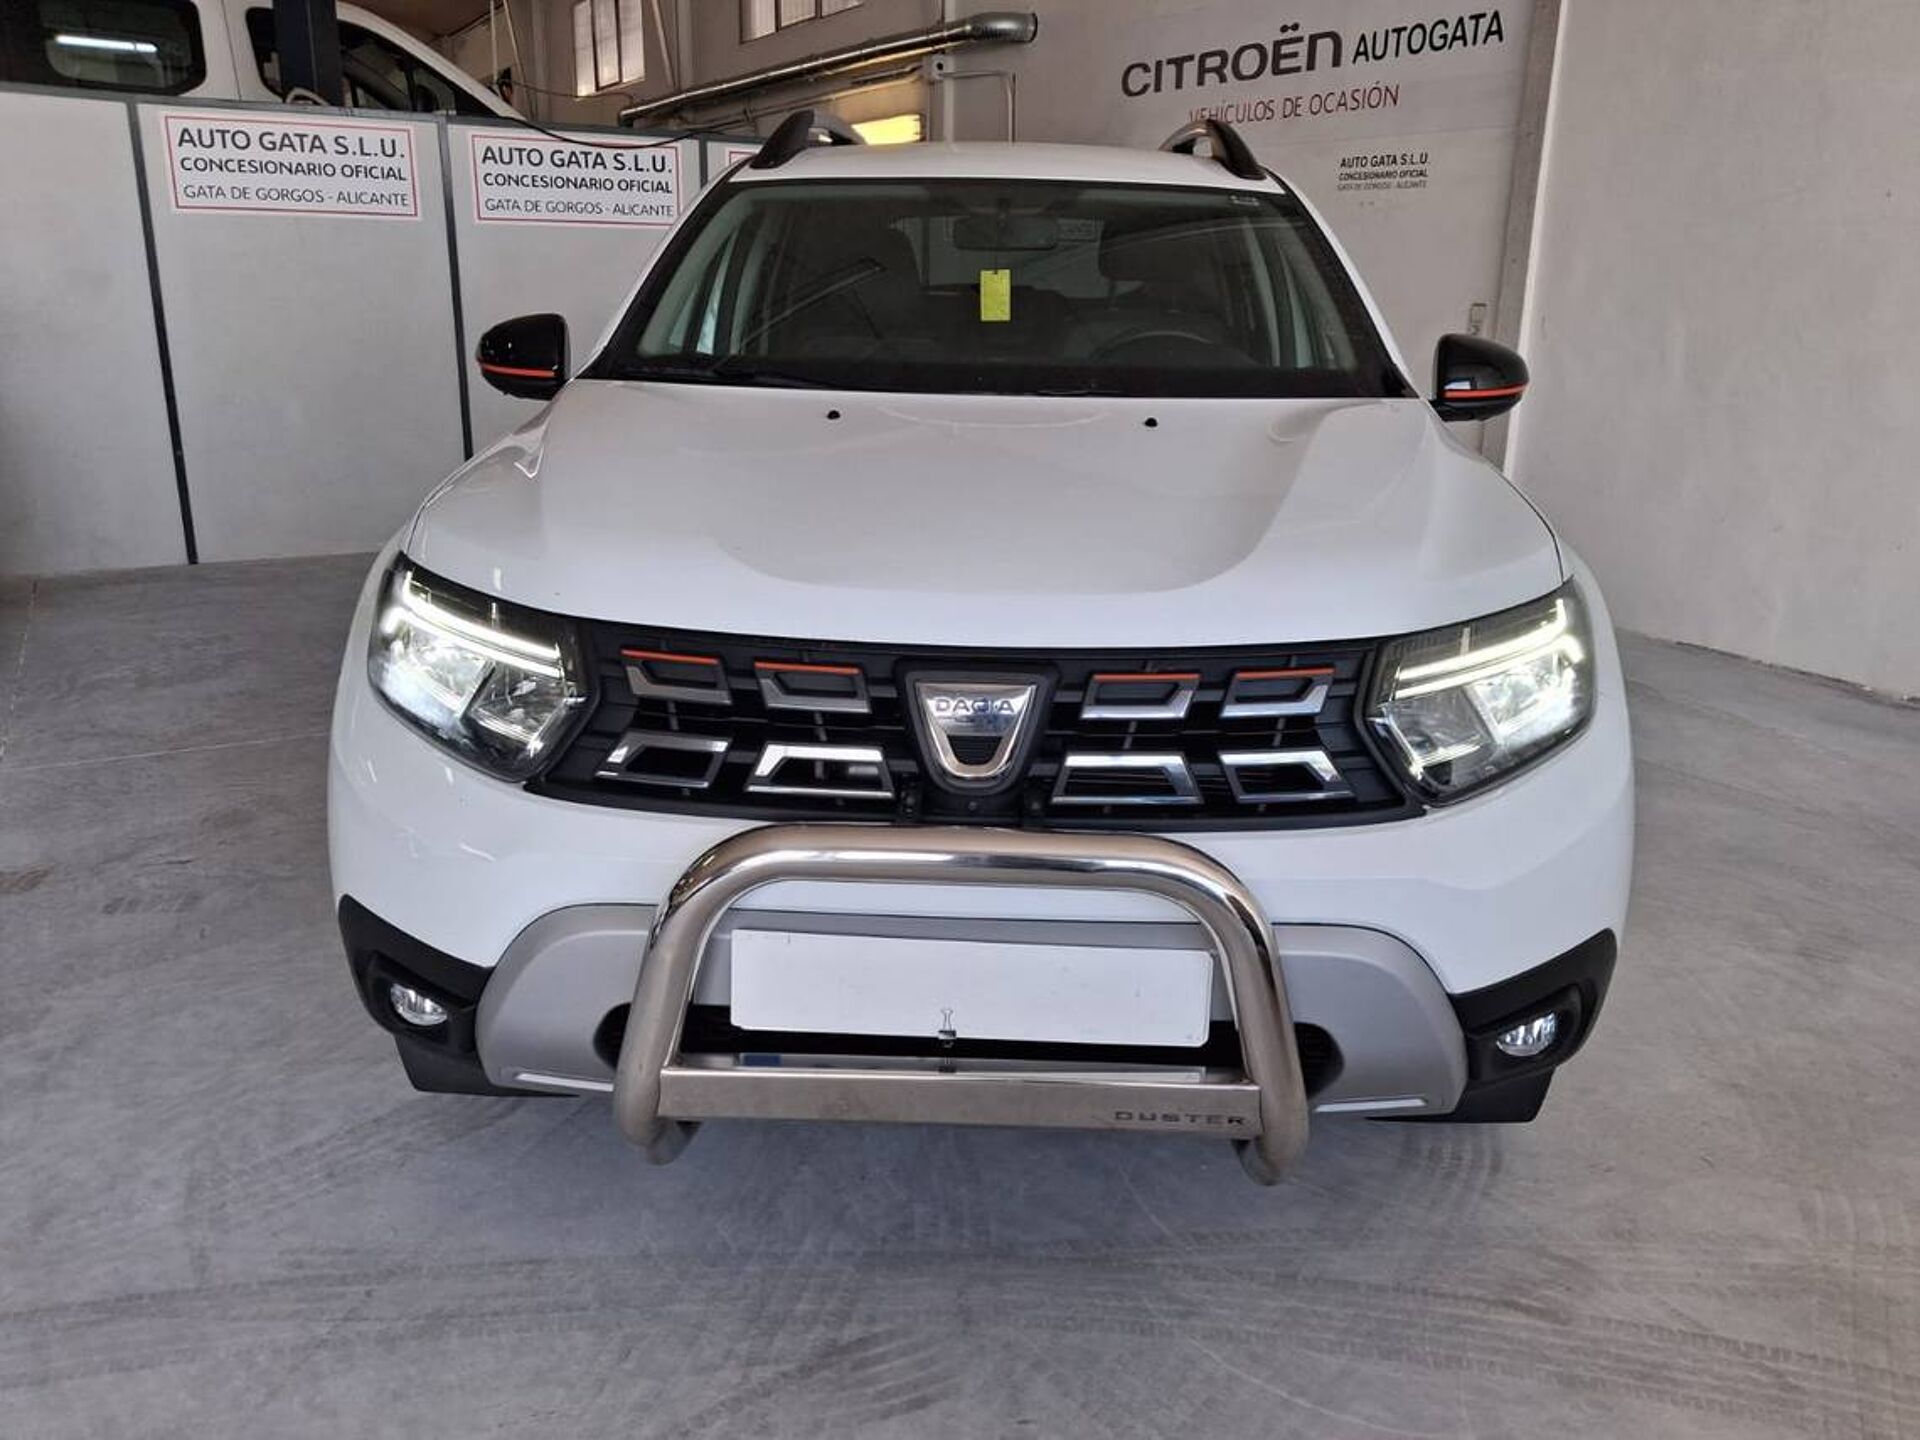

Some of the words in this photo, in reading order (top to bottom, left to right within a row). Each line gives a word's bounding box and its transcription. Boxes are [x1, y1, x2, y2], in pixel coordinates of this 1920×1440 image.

[1352, 9, 1504, 65] AUTOGATA
[1282, 96, 1303, 119] DE
[1309, 81, 1400, 115] OCASIÓN
[178, 127, 251, 150] AUTO
[258, 131, 328, 154] GATA
[333, 135, 406, 158] S.L.U.
[180, 157, 336, 177] CONCESIONARIO
[341, 166, 408, 181] OFICIAL
[482, 145, 544, 167] AUTO
[550, 150, 607, 170] GATA
[613, 153, 673, 173] S.L.U.
[1340, 156, 1368, 169] AUTO
[1371, 154, 1398, 168] GATA
[483, 173, 614, 191] CONCESIONARIO
[617, 179, 673, 194] OFICIAL
[183, 184, 226, 200] GATA
[230, 186, 251, 200] DE
[255, 188, 325, 203] GORGOS
[336, 191, 409, 207] ALICANTE
[485, 198, 522, 211] GATA
[524, 200, 542, 213] DE
[545, 201, 603, 215] GORGOS
[612, 204, 674, 218] ALICANTE
[935, 698, 1015, 713] DACIA
[1115, 1111, 1246, 1126] DUSTER
